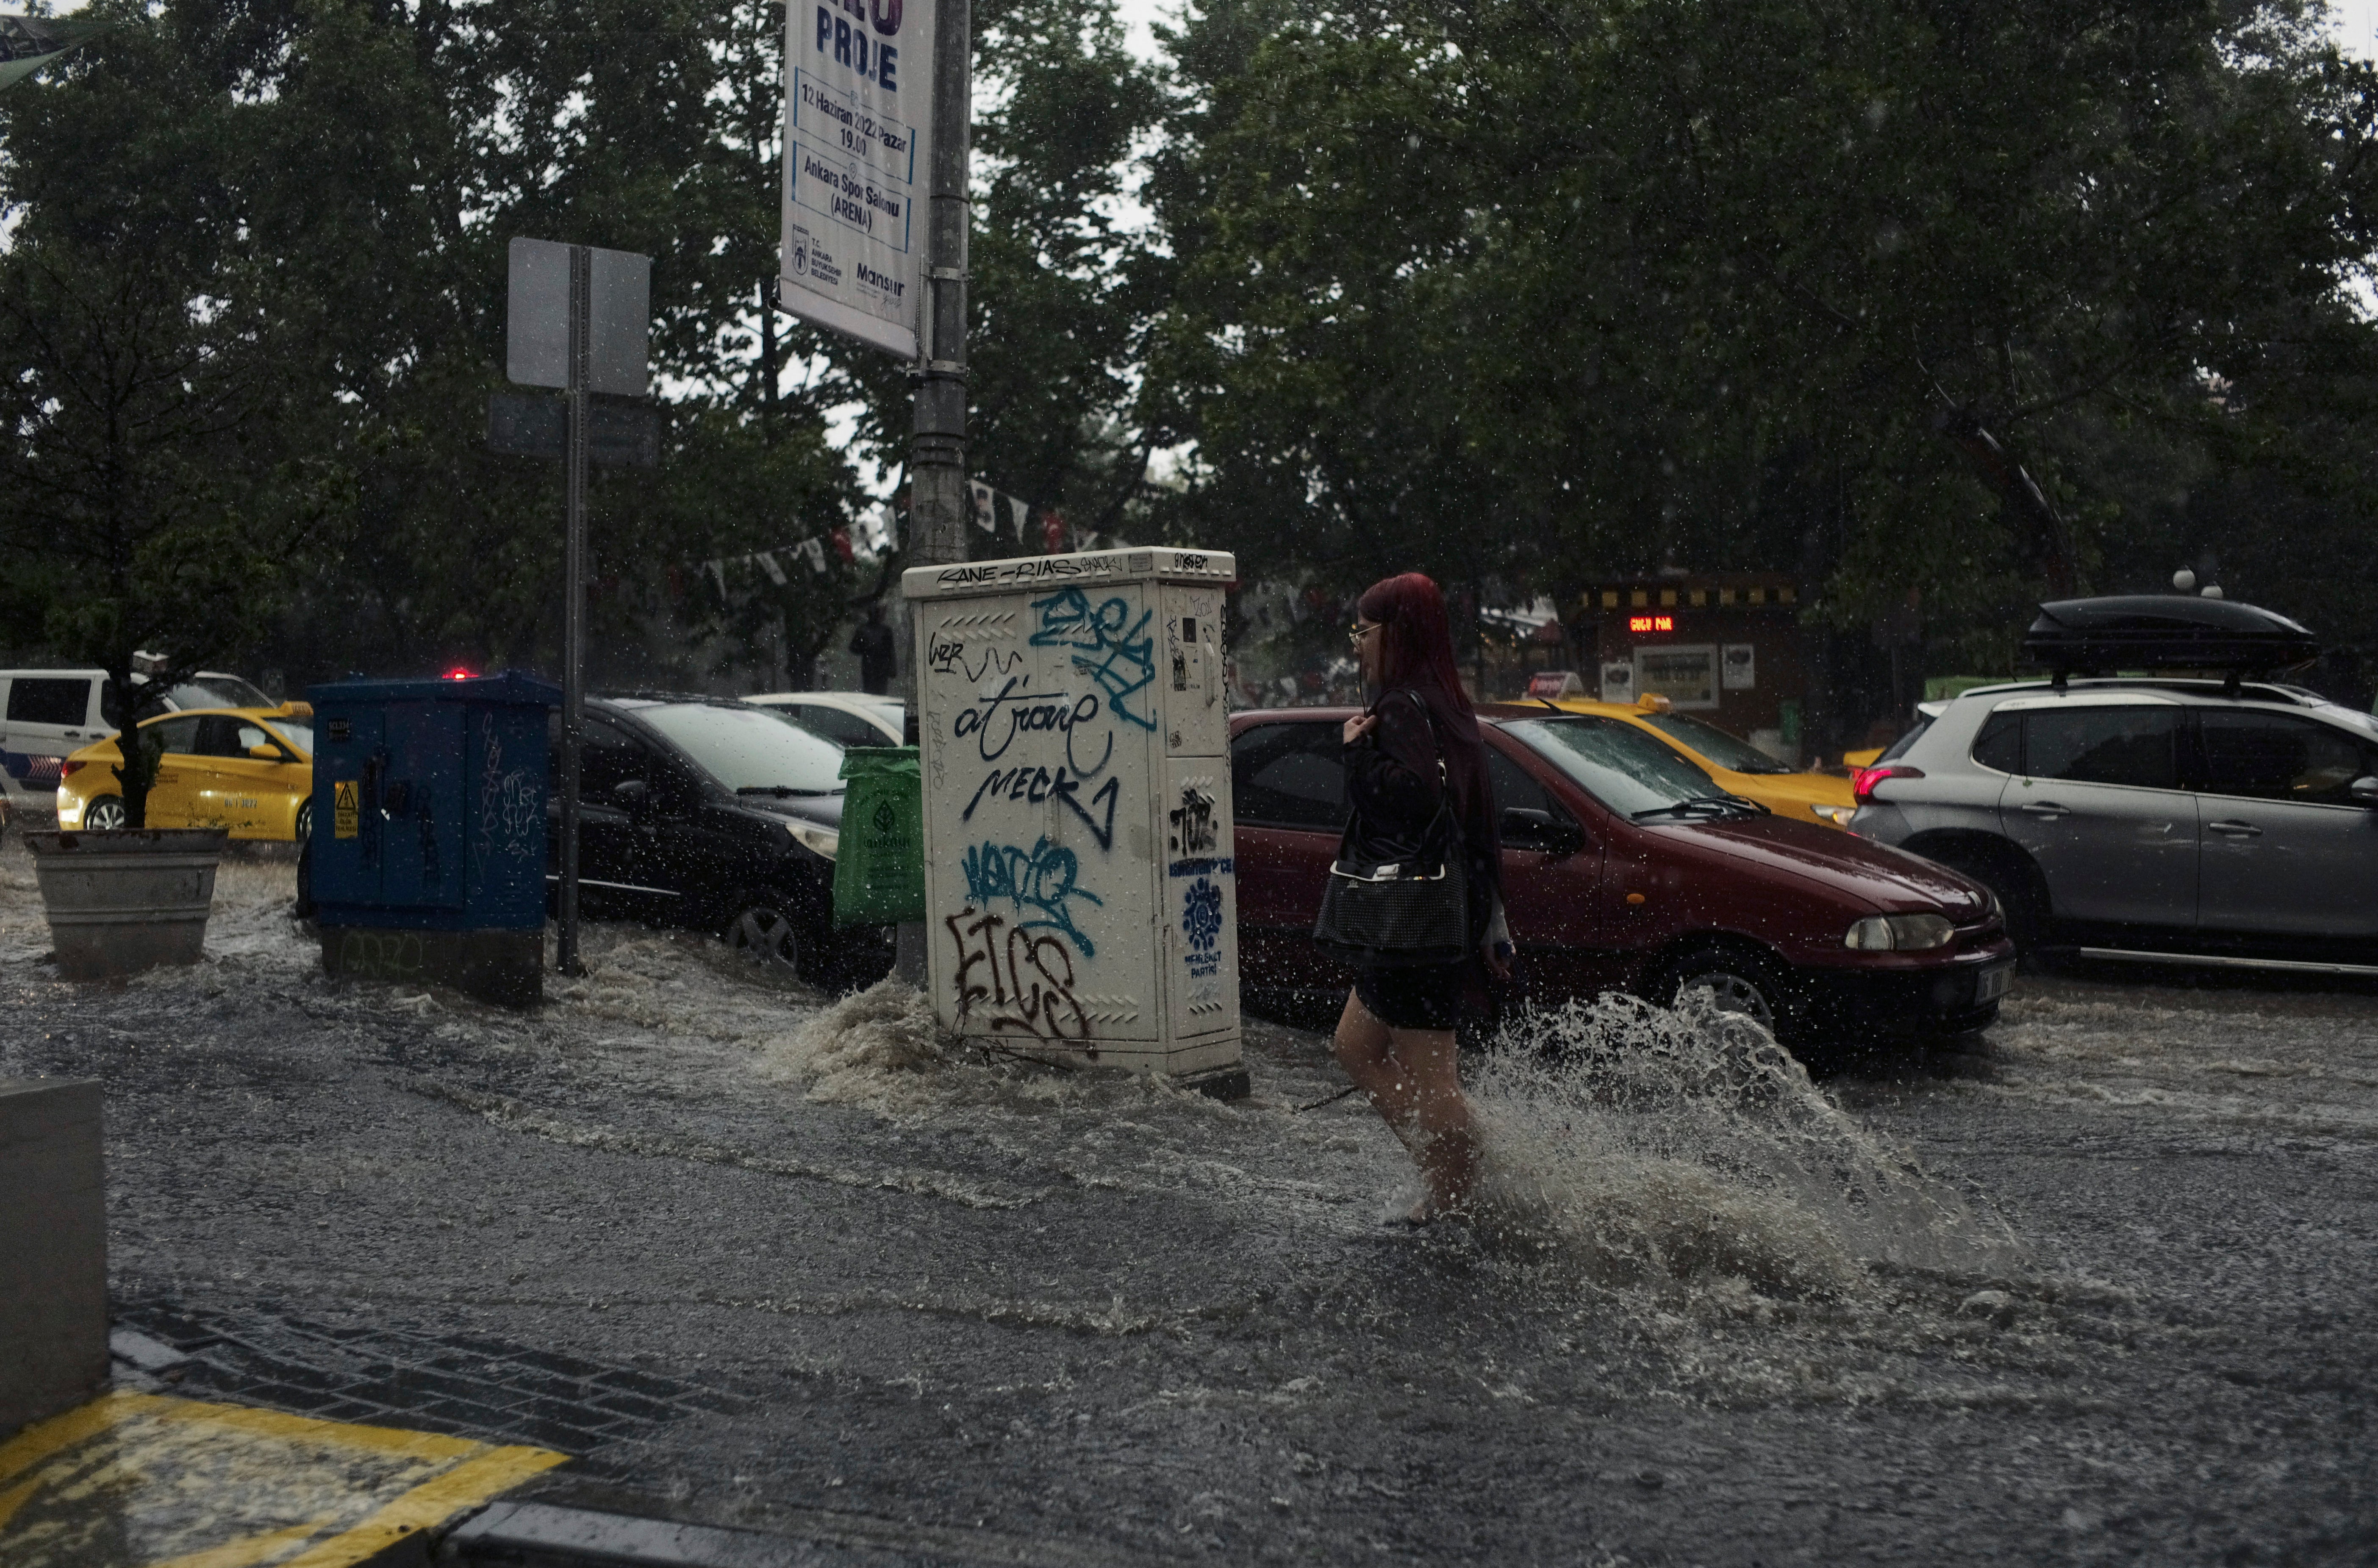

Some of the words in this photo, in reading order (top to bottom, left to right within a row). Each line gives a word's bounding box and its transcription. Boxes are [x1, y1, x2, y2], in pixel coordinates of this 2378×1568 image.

[817, 5, 898, 92] PROJE
[802, 84, 814, 106] 12
[816, 90, 852, 126] Haziran
[855, 111, 877, 139] 2022
[878, 125, 906, 153] Pazar
[841, 128, 866, 156] 19.00
[805, 155, 838, 188] Ankara
[841, 174, 864, 200] Spor
[866, 186, 899, 217] Salonu
[831, 192, 872, 233] (ARENA)
[812, 248, 832, 263] ANKARA
[857, 263, 905, 297] Mansur
